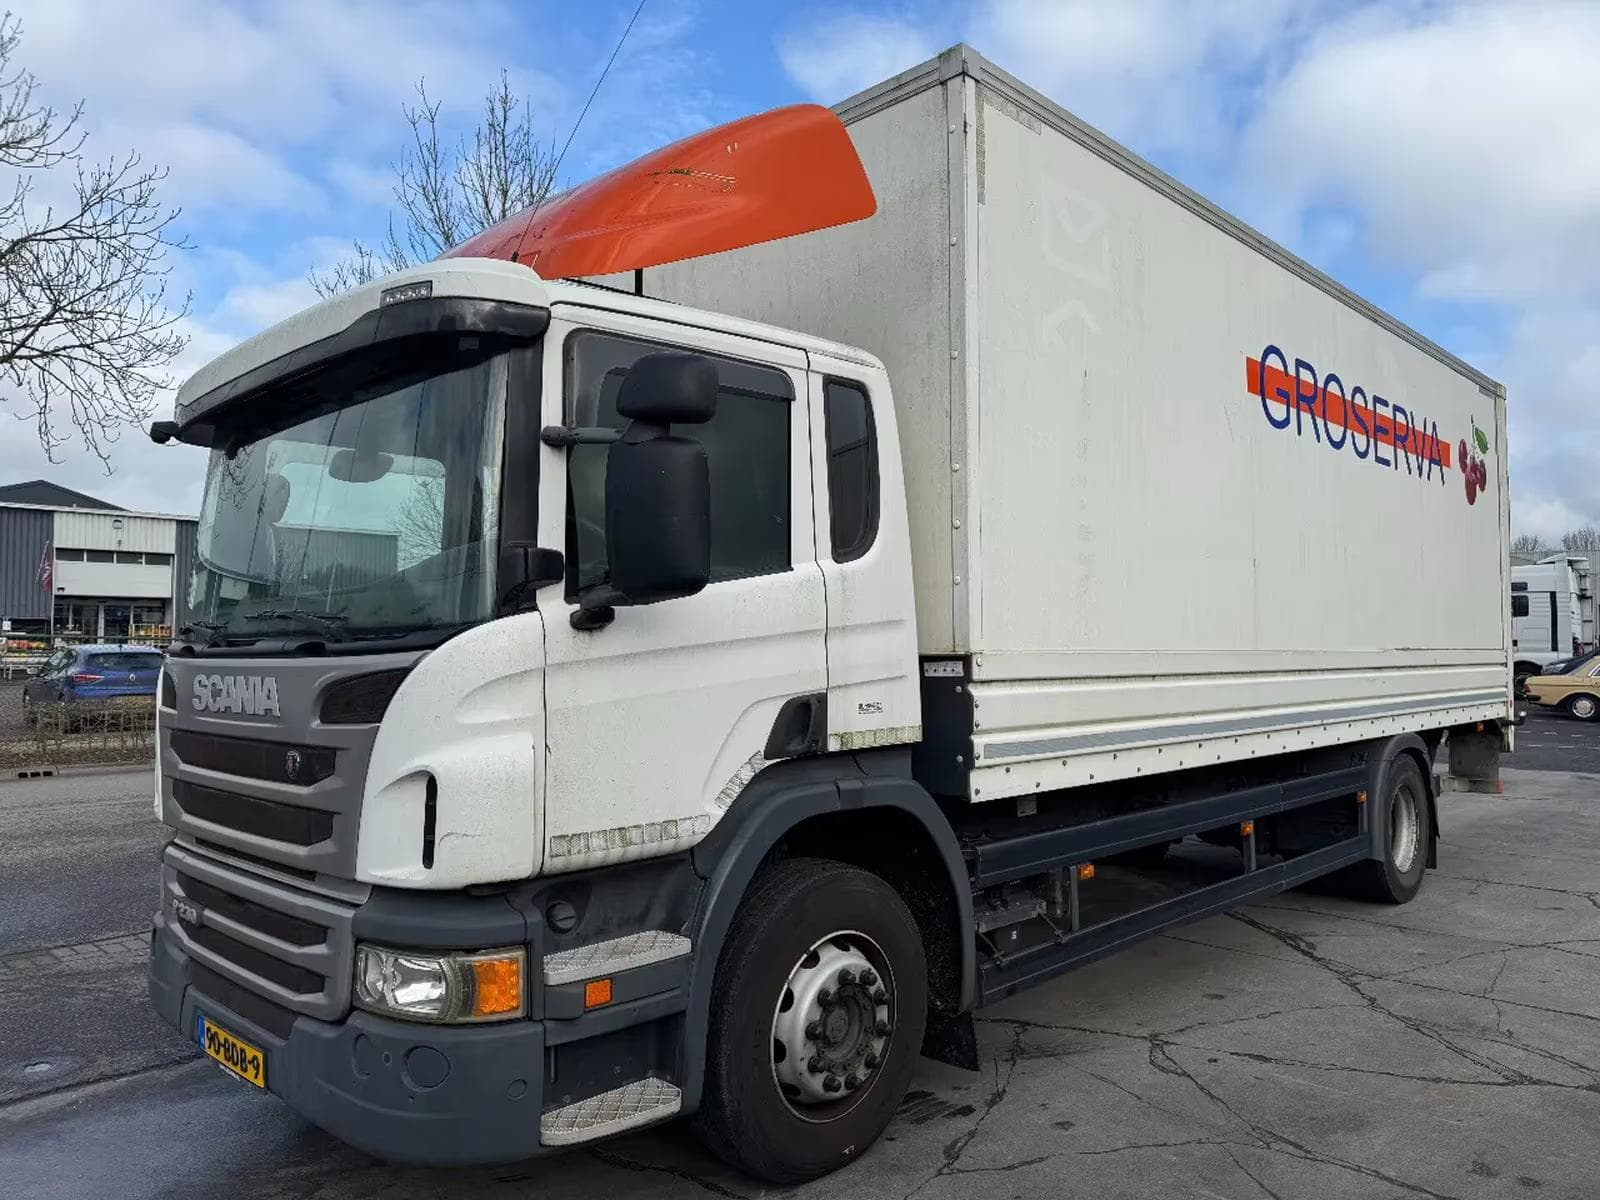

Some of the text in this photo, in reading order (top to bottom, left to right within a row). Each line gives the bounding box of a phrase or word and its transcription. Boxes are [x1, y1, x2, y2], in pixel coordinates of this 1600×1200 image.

[1260, 345, 1446, 487] GROSERVA
[192, 674, 280, 717] SCANIA
[206, 1026, 260, 1079] 90-BDB-9
